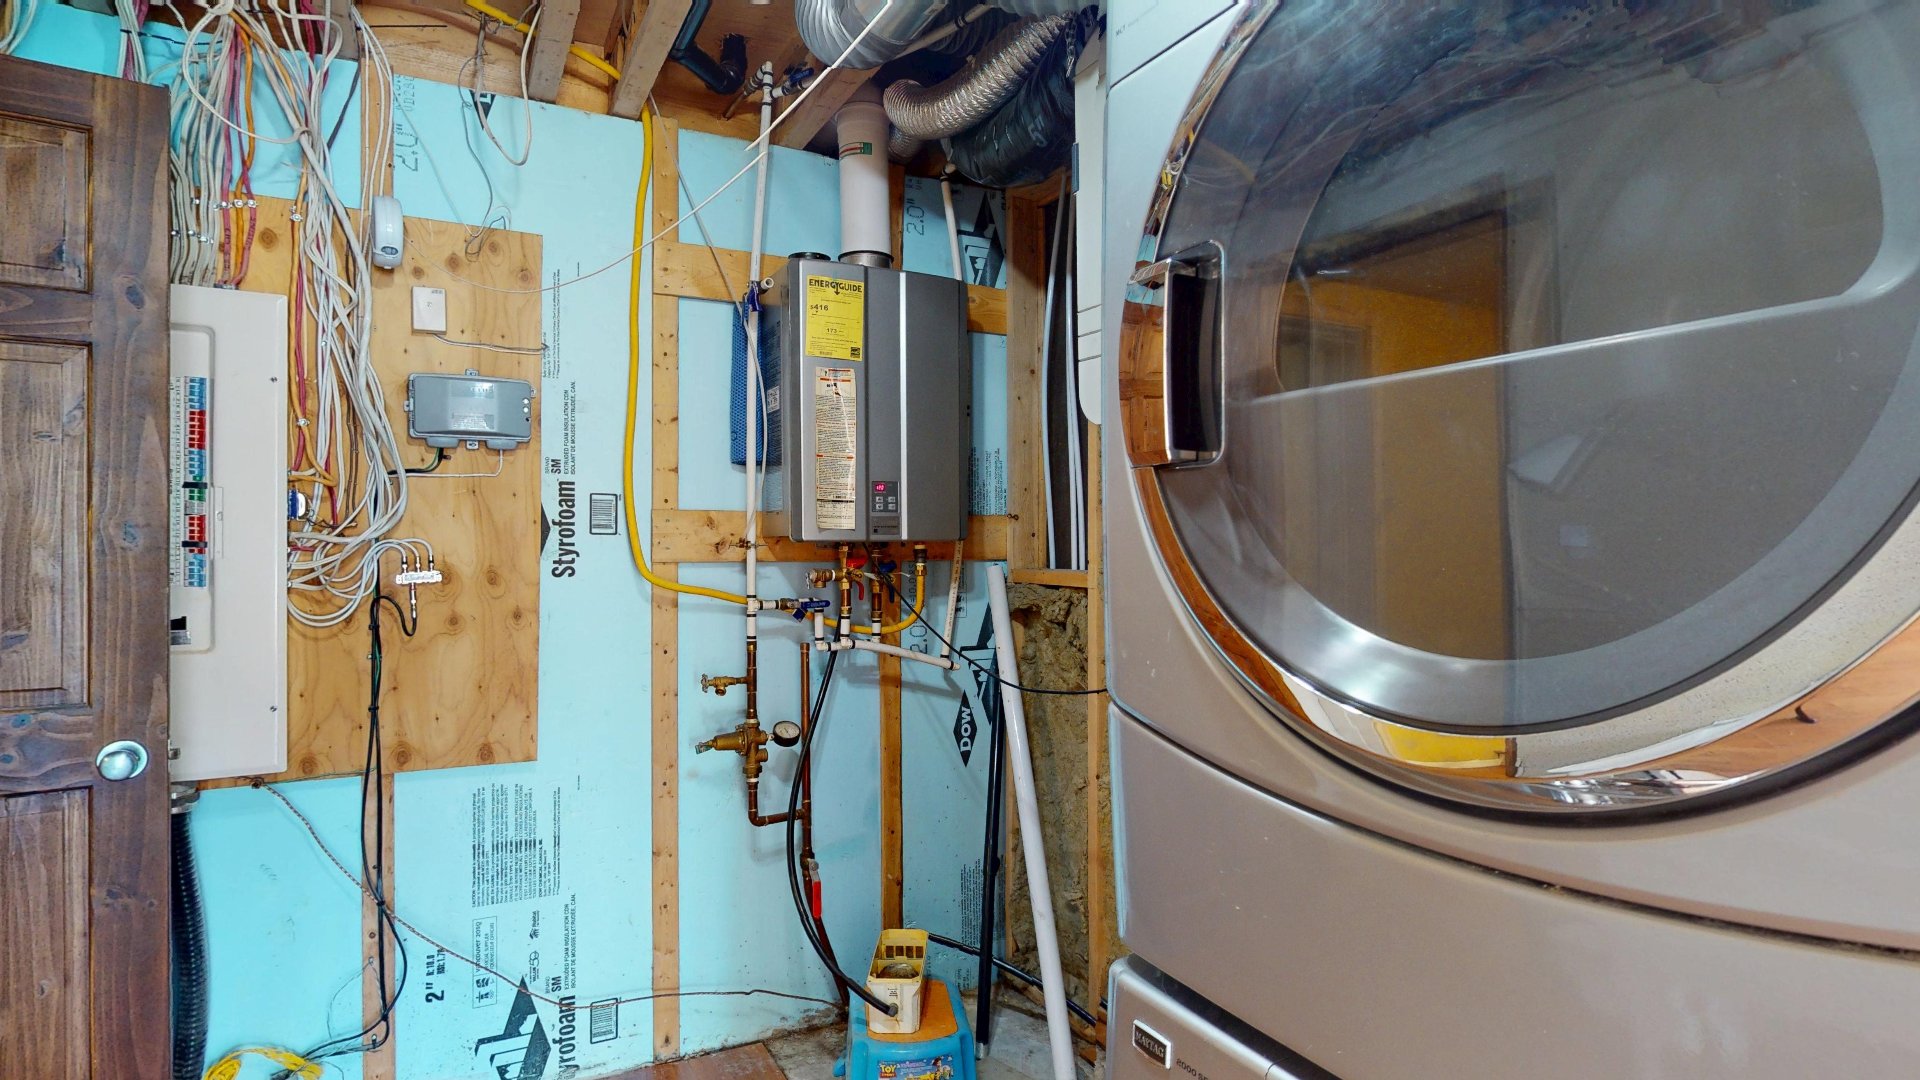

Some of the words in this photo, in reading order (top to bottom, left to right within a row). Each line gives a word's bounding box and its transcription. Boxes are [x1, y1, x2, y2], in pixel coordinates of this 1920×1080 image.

[906, 198, 925, 236] 2.0"
[809, 279, 863, 293] ENERGYGUIDE
[569, 422, 577, 444] MOUSSE
[569, 444, 577, 453] DE
[550, 458, 561, 475] SM
[569, 453, 577, 475] ISOLANT
[551, 480, 580, 578] Styrofoam
[959, 706, 972, 752] DOW
[569, 958, 577, 967] DE
[425, 982, 445, 1004] 2"
[551, 976, 562, 993] SM
[551, 995, 580, 1075] yrofoam
[1135, 1031, 1165, 1058] MAYTAG
[880, 1064, 897, 1073] TOY
[1176, 1058, 1198, 1077] 2000
